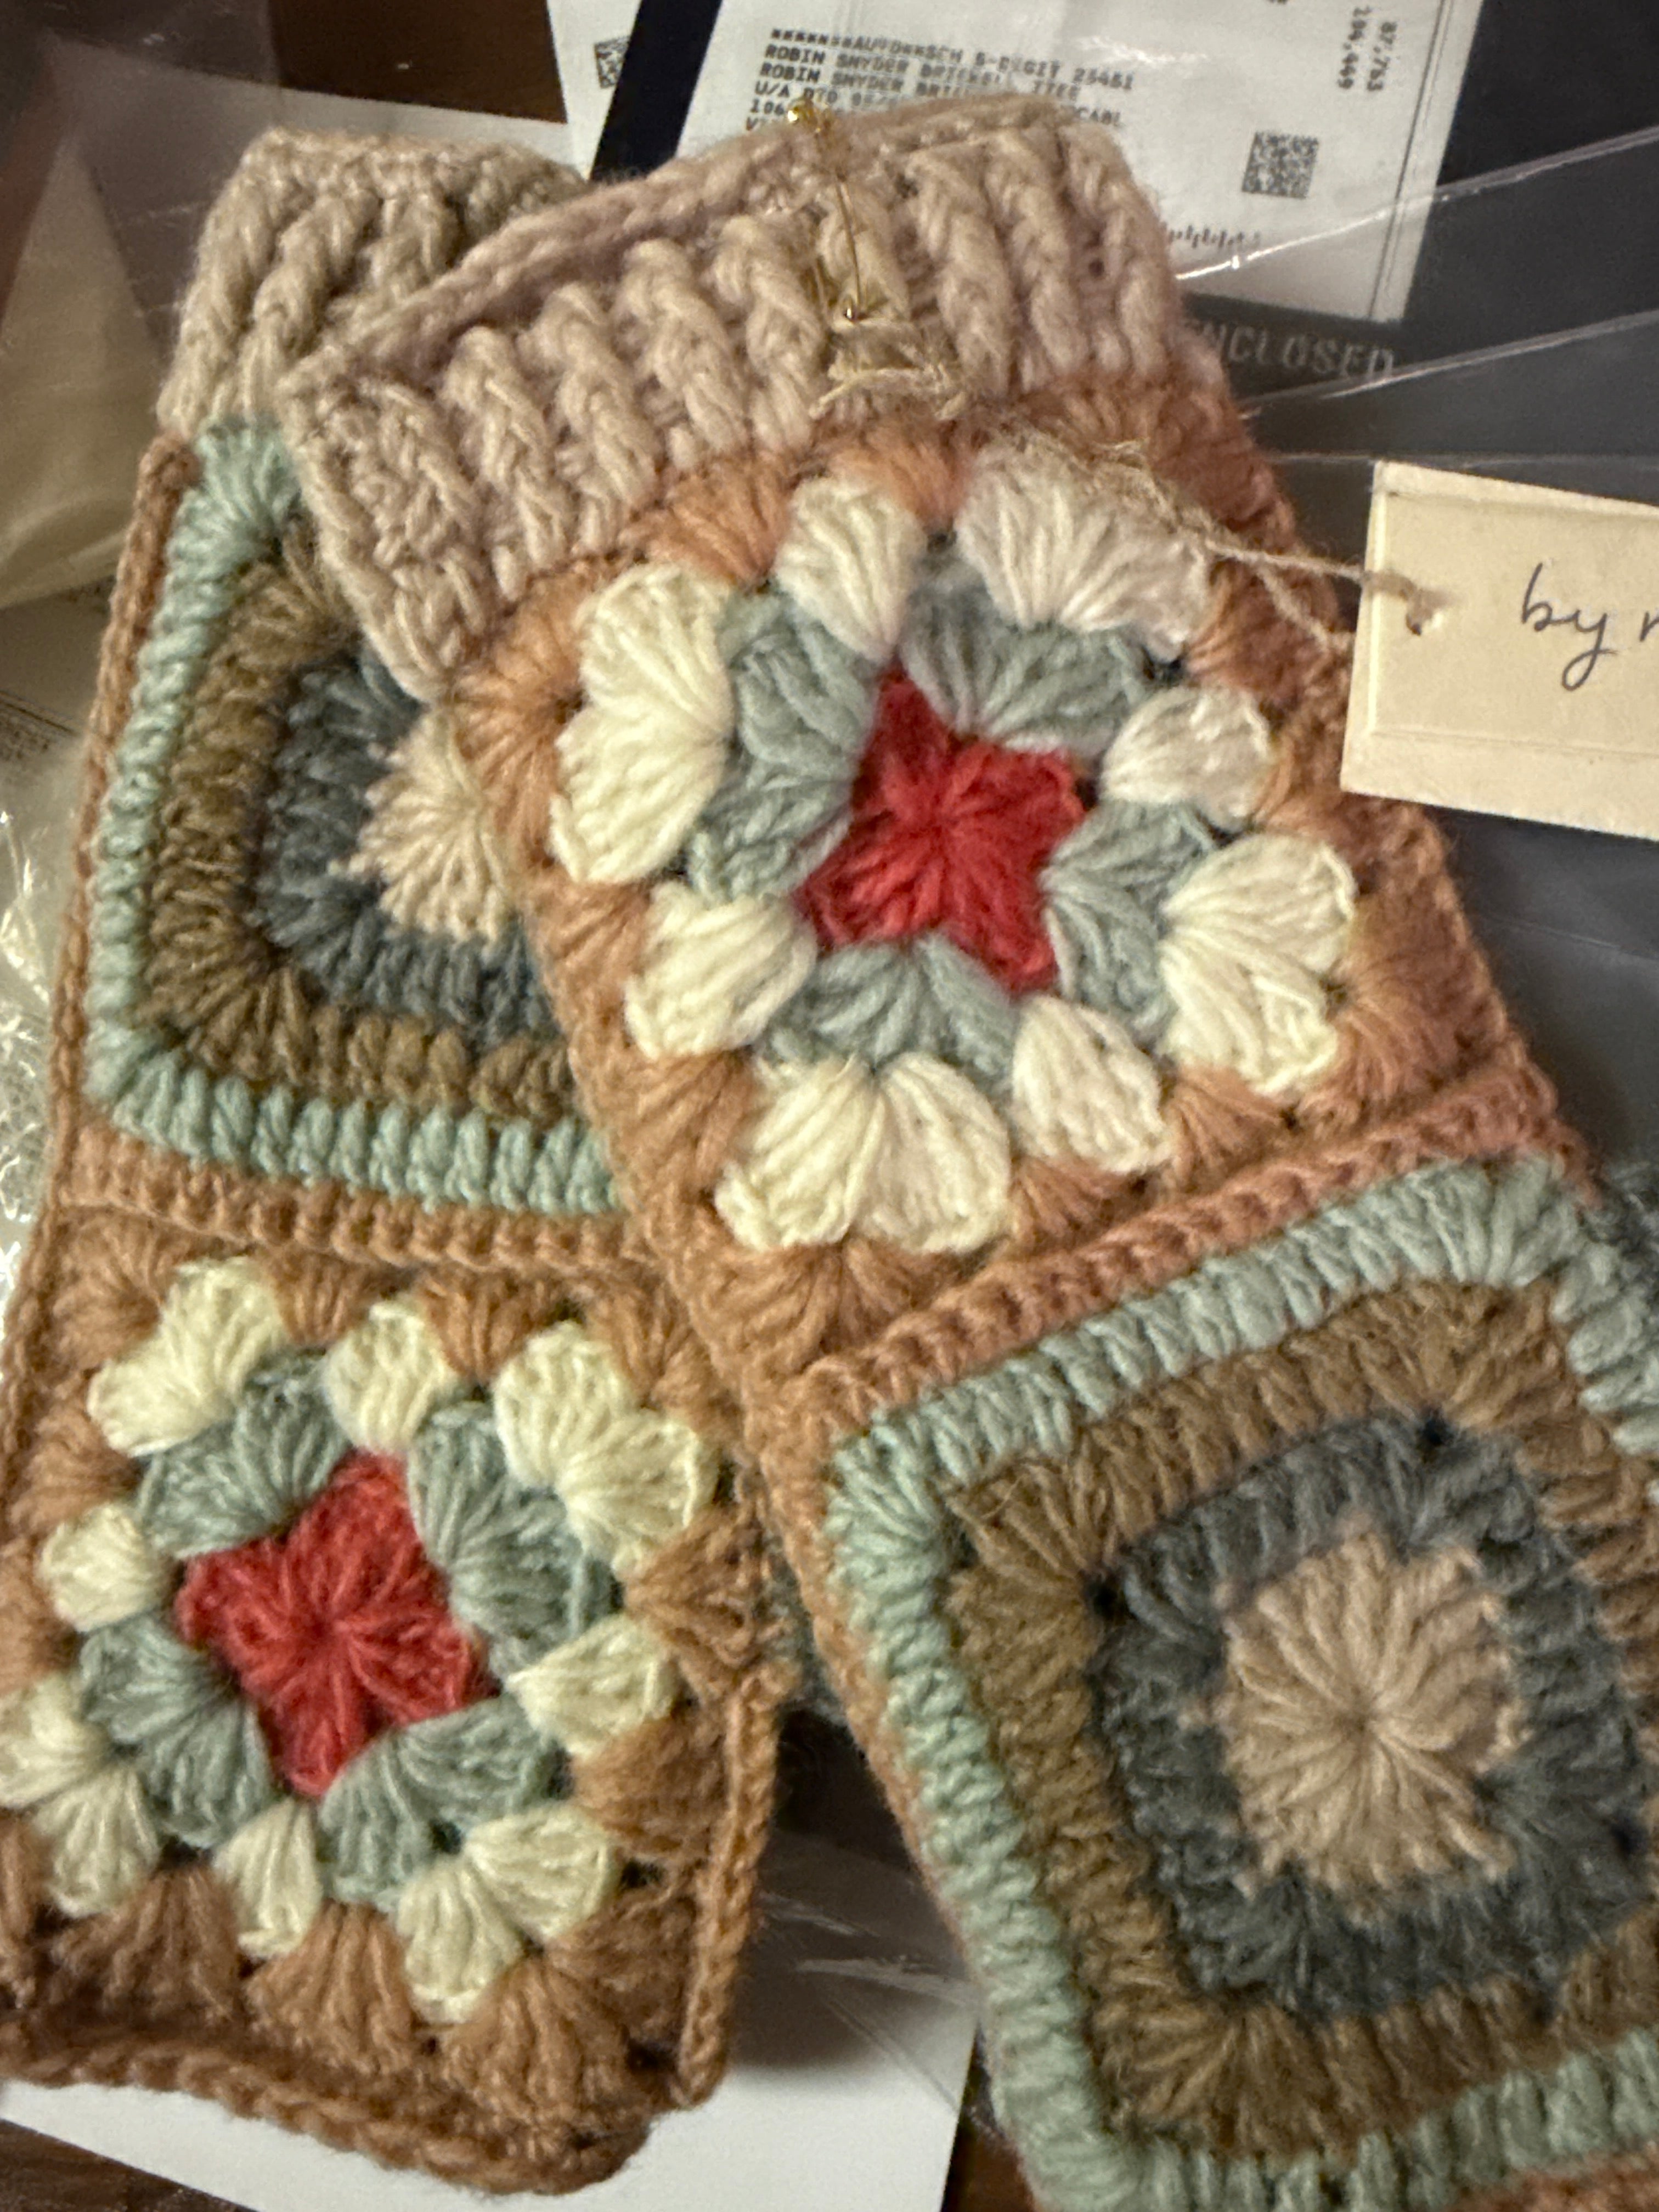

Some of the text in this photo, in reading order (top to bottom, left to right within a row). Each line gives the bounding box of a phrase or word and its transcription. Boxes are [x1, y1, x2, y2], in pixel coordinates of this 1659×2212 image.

[765, 43, 826, 65] ROBIN
[759, 62, 821, 83] ROBIN
[754, 81, 790, 98] U/A
[1522, 562, 1618, 691] by
